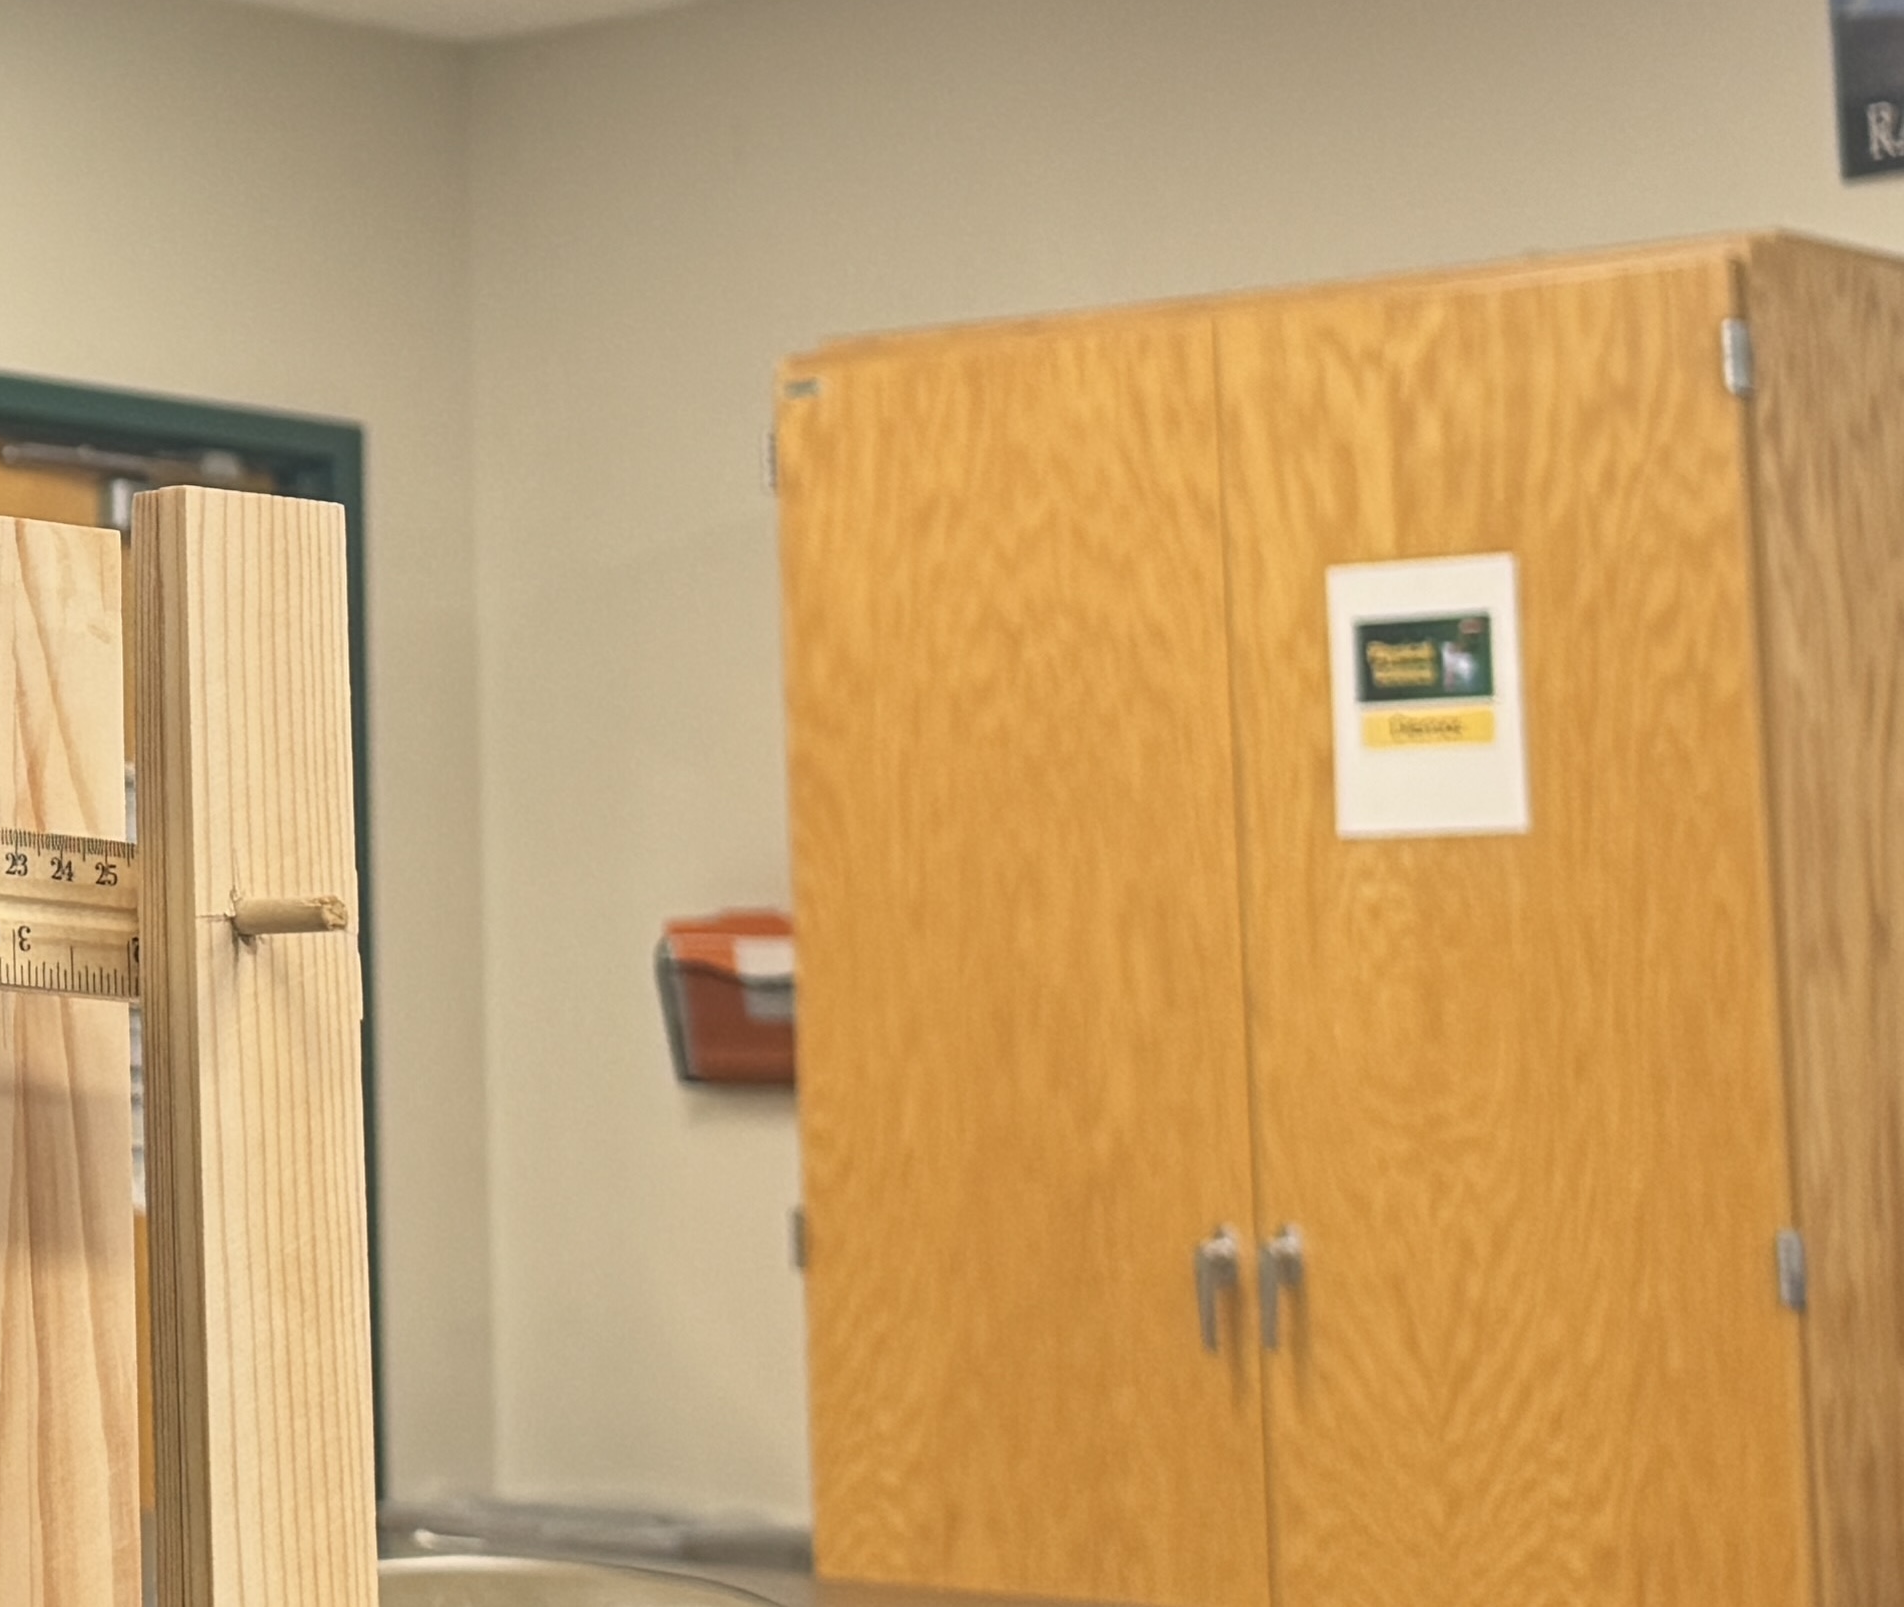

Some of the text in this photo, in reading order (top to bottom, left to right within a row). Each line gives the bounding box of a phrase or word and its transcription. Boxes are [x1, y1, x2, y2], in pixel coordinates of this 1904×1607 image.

[5, 853, 28, 877] 23
[50, 857, 74, 882] 24
[95, 861, 118, 886] 25
[18, 925, 32, 951] 3
